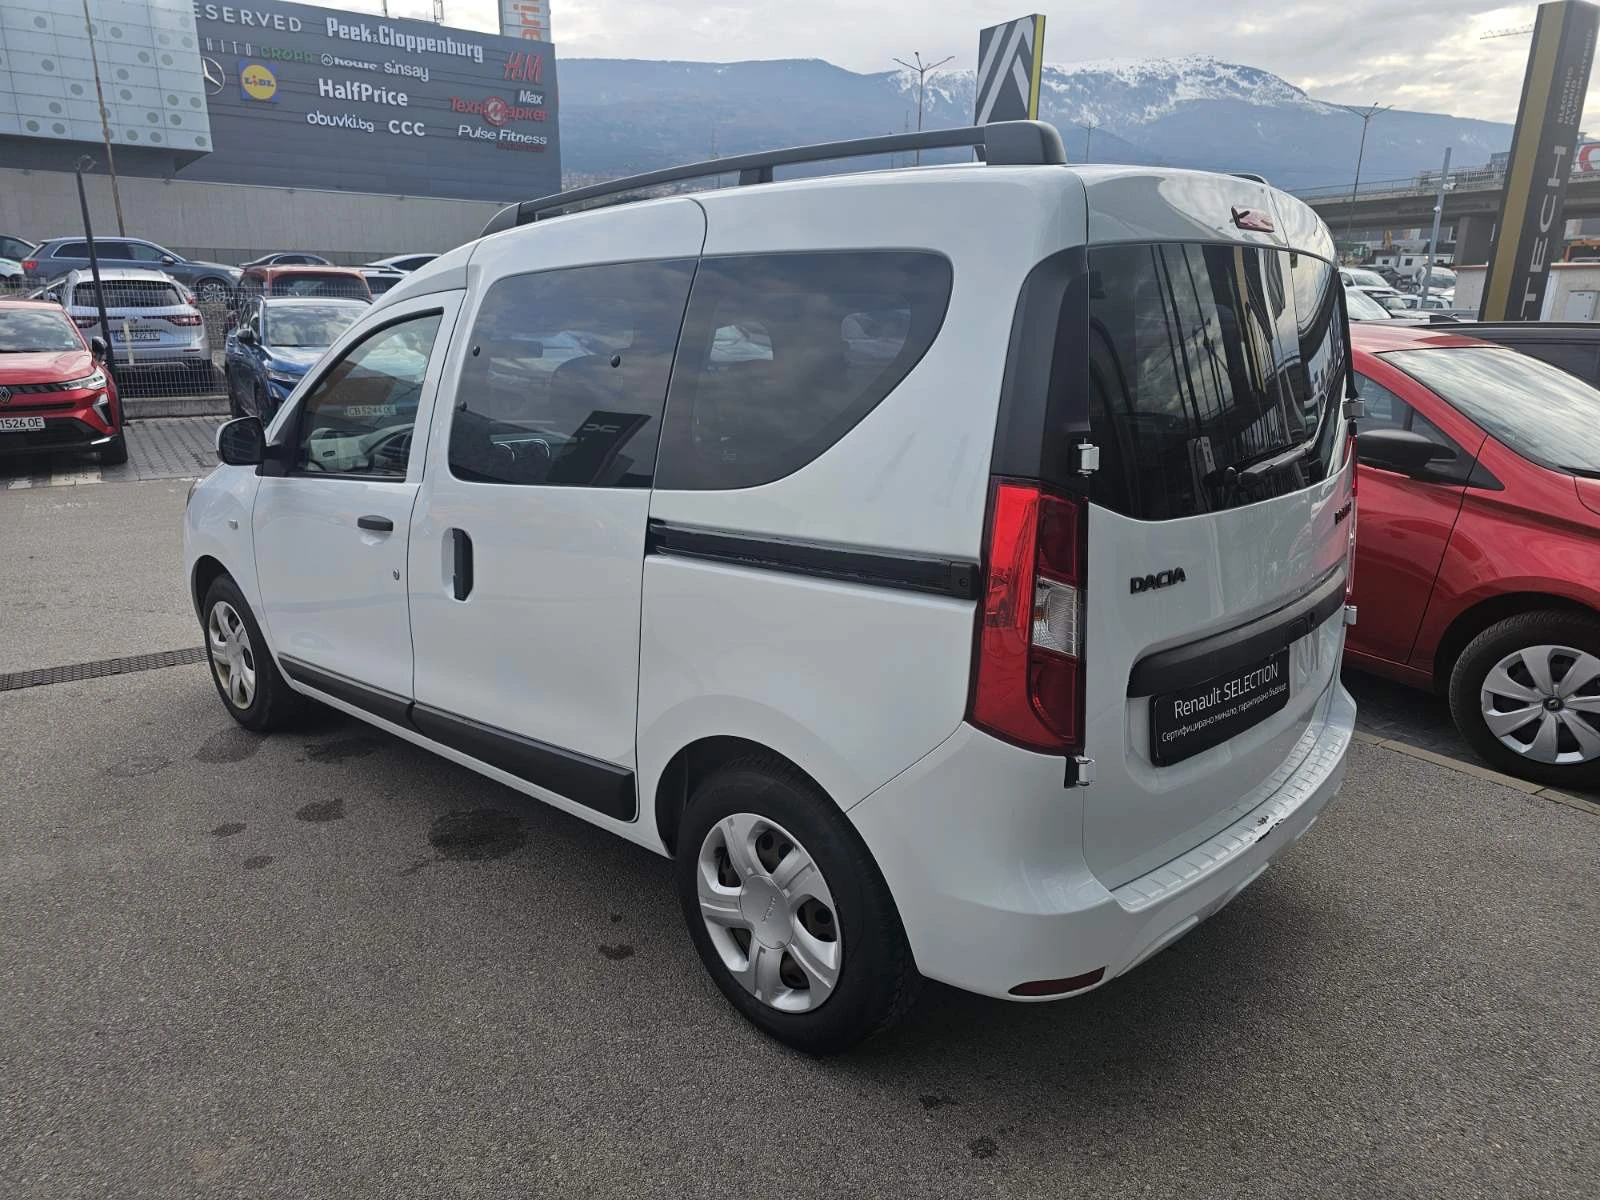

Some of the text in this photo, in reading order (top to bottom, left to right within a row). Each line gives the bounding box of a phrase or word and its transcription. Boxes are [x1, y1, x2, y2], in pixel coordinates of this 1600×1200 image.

[318, 78, 408, 107] HalfPrice
[306, 110, 375, 133] obuvki.bg
[458, 125, 548, 145] Pulse Fitness
[0, 418, 26, 429] 1526
[1130, 567, 1186, 594] DACIA
[1174, 661, 1279, 719] Renault SELECTION
[1162, 715, 1215, 742] Сертифицирано
